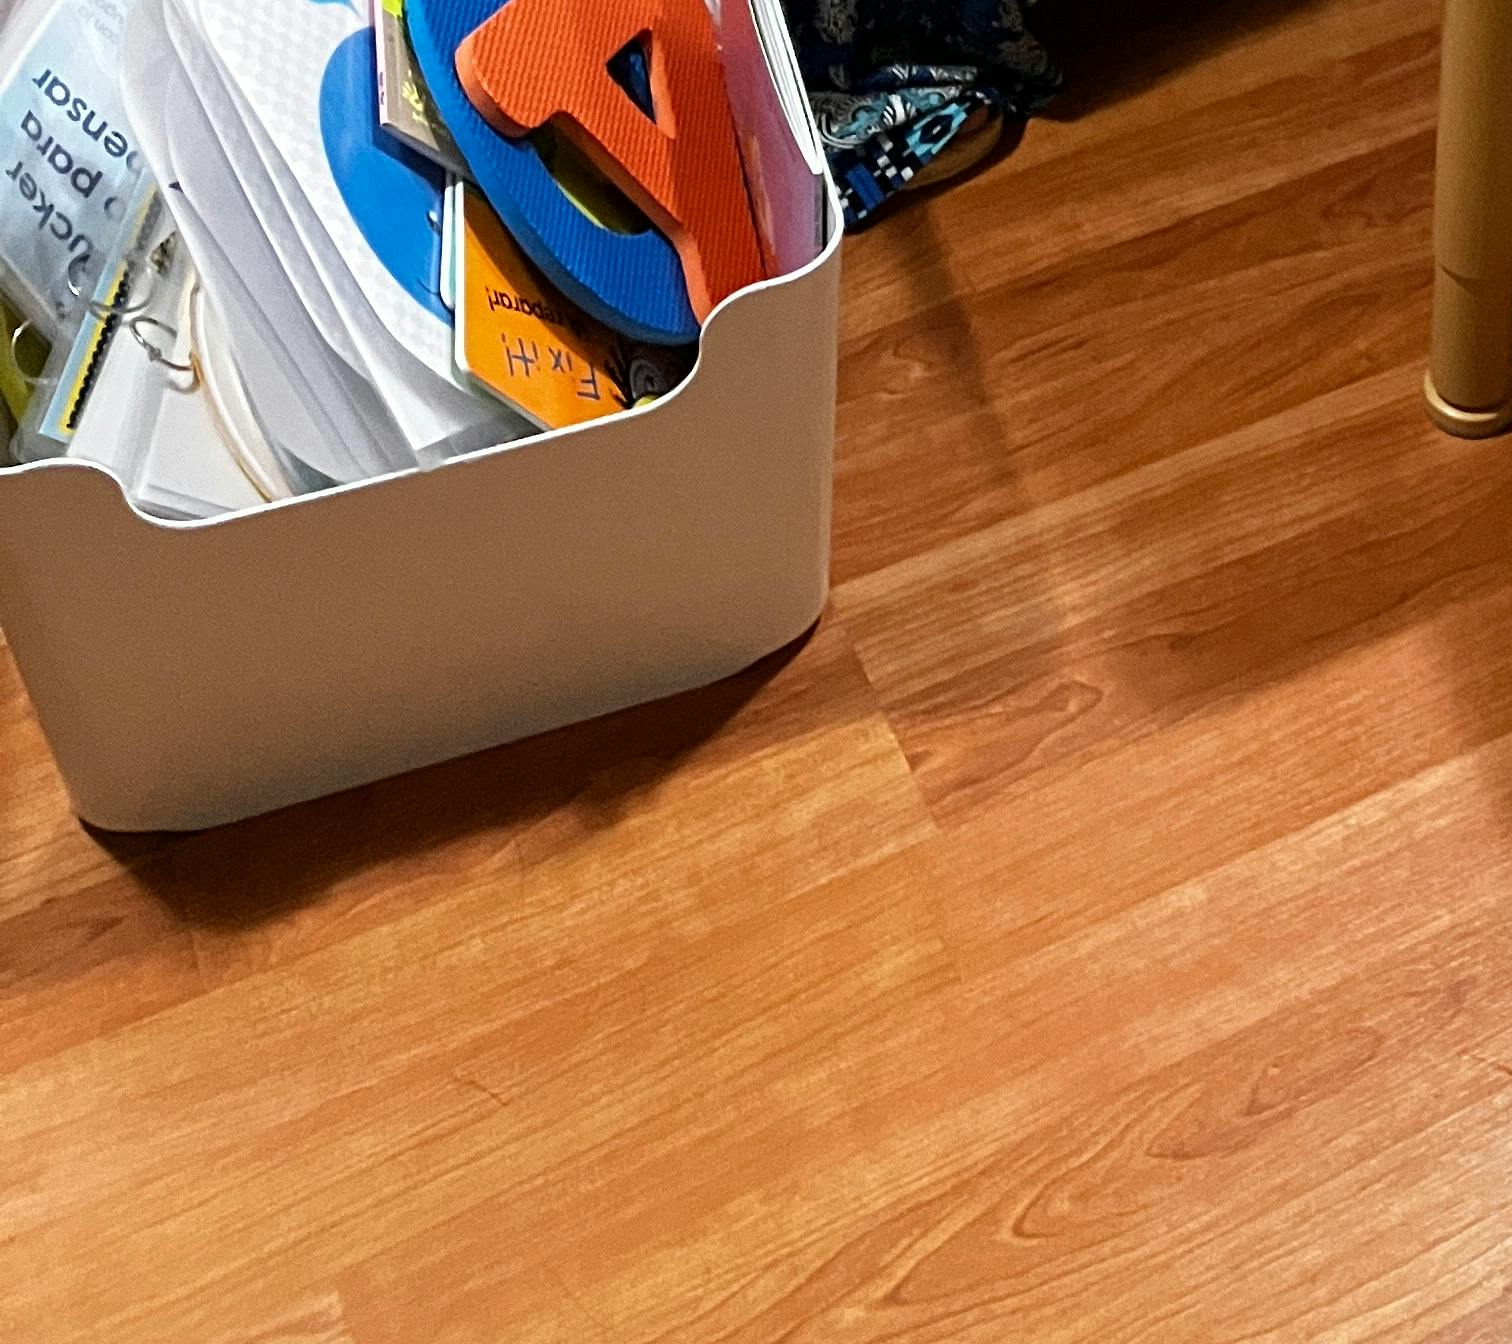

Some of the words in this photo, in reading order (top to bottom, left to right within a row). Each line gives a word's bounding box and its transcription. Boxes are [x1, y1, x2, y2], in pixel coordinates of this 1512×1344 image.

[20, 110, 103, 199] para
[501, 333, 541, 377] it!
[548, 346, 601, 401] Fix
